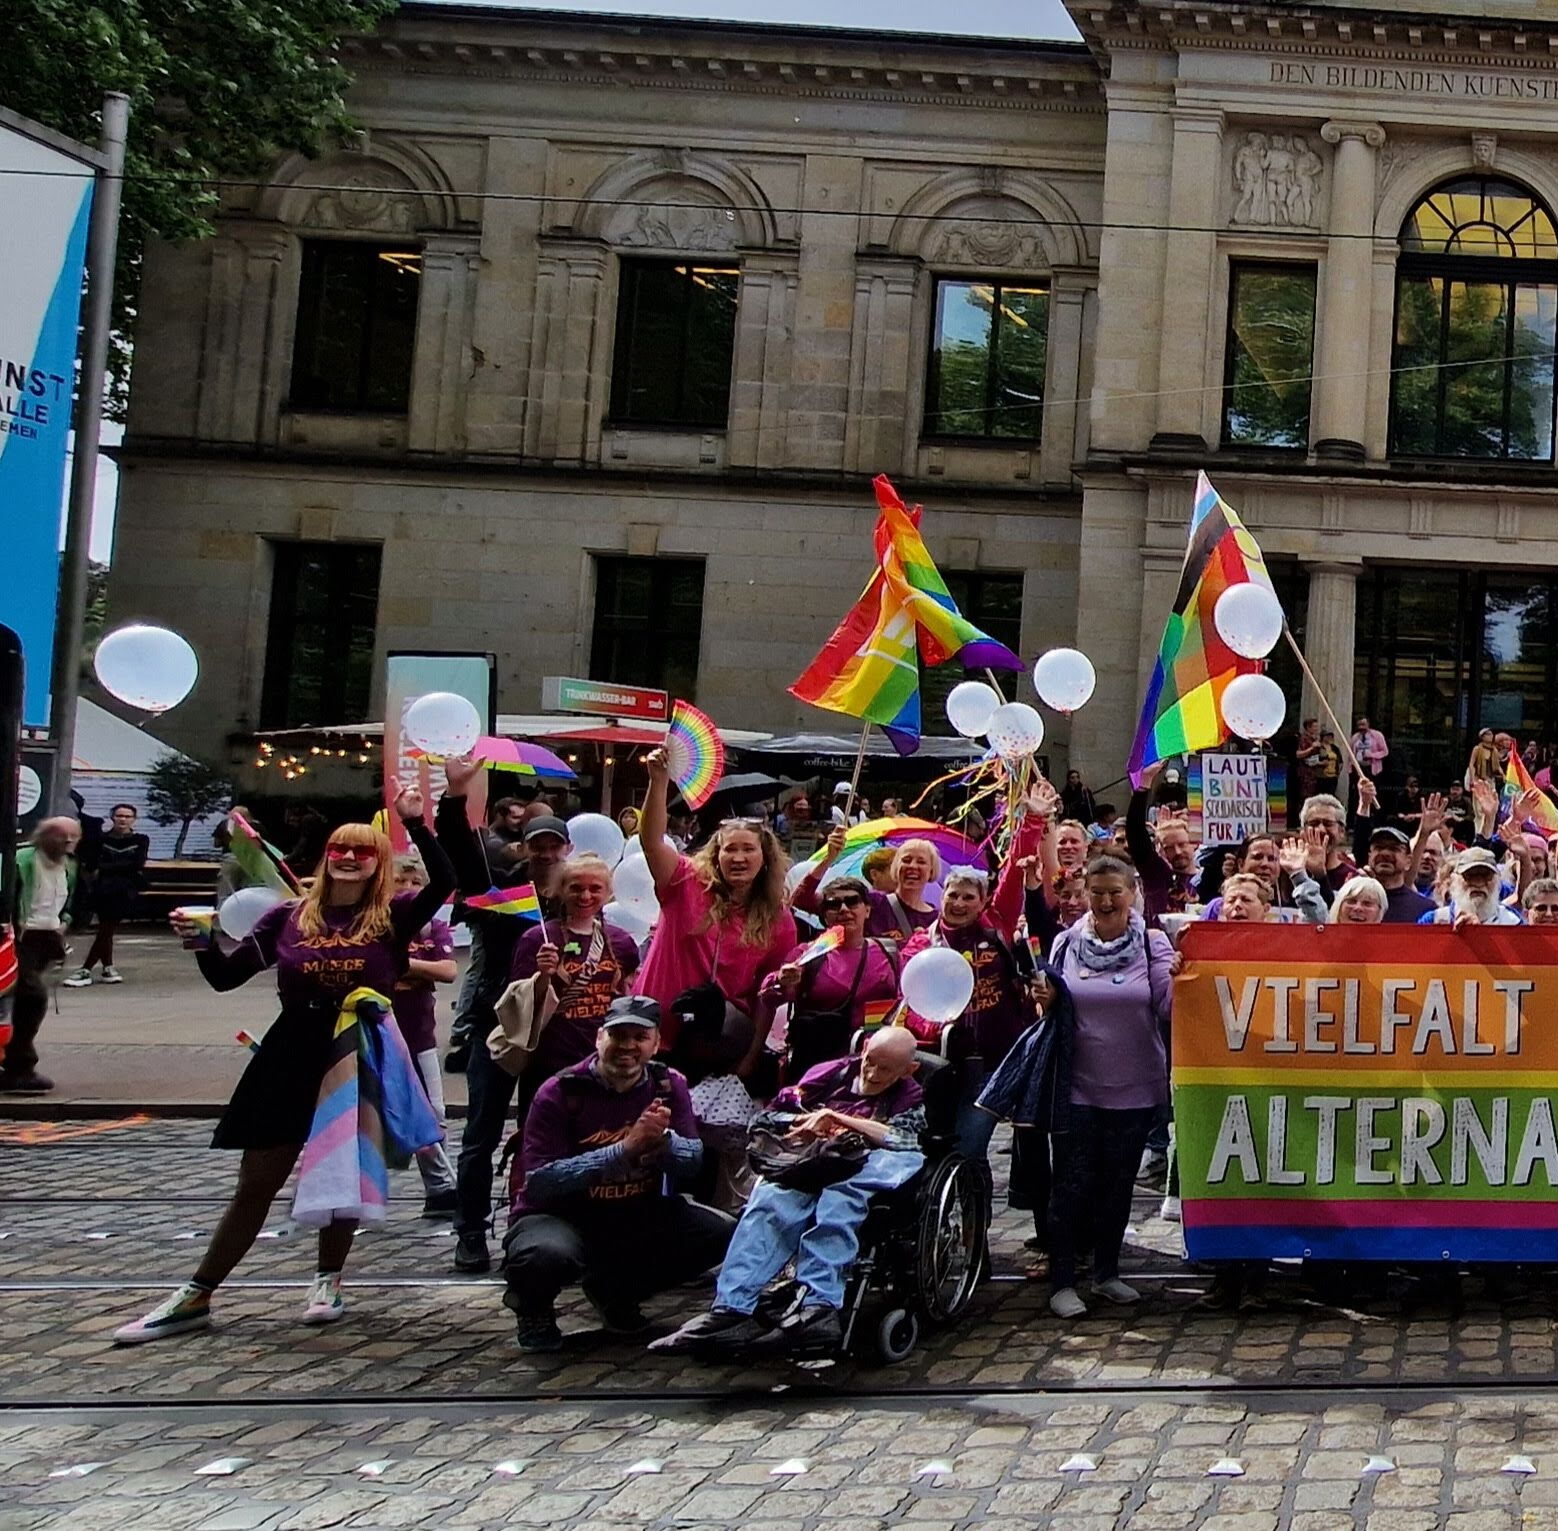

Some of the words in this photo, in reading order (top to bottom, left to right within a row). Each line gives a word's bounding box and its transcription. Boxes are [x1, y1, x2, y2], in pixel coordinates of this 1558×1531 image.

[1270, 62, 1316, 85] DEN
[1326, 65, 1455, 93] BILDENDEN
[0, 359, 65, 401] NST
[1208, 758, 1261, 776] LAUT
[1209, 778, 1263, 798] BUNT
[1214, 976, 1535, 1057] VIELFALT
